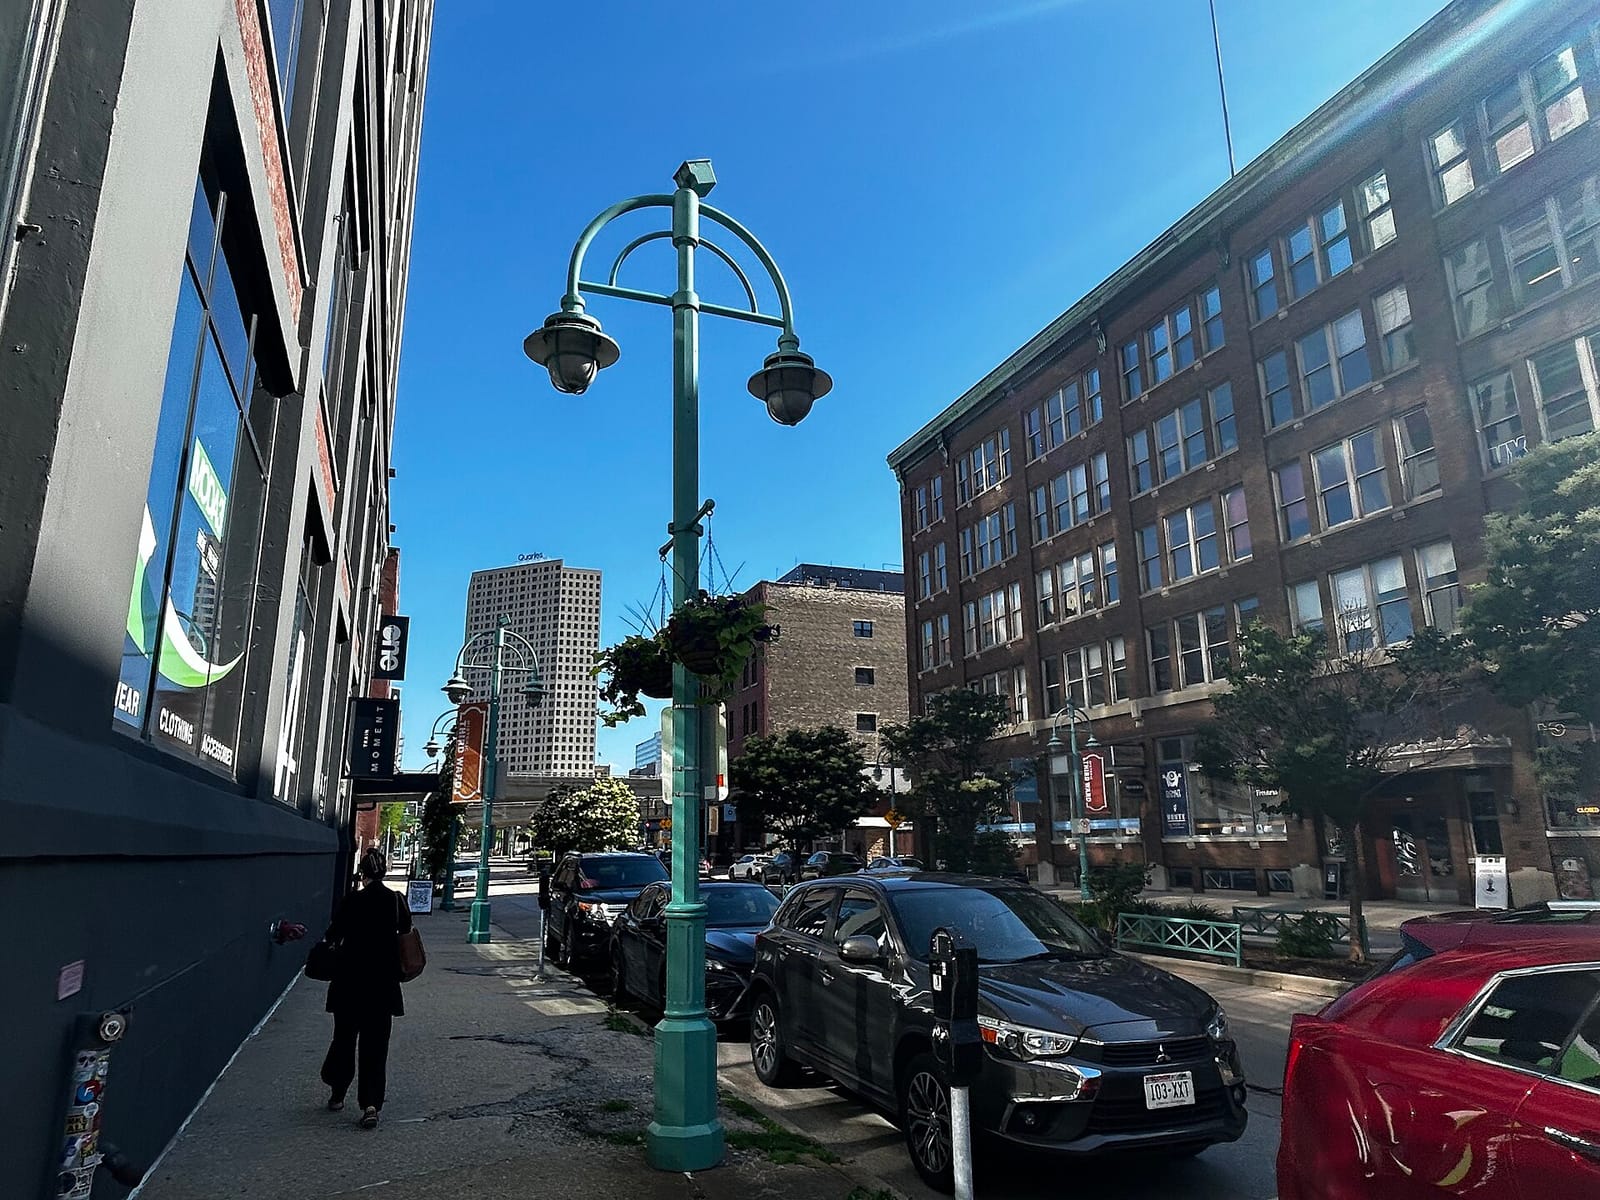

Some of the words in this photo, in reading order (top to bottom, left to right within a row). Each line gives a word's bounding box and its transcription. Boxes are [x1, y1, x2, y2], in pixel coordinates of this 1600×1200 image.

[159, 707, 194, 745] CLOTHING
[370, 706, 384, 773] MOMENT
[457, 720, 466, 753] THIRD
[454, 757, 464, 789] WARD
